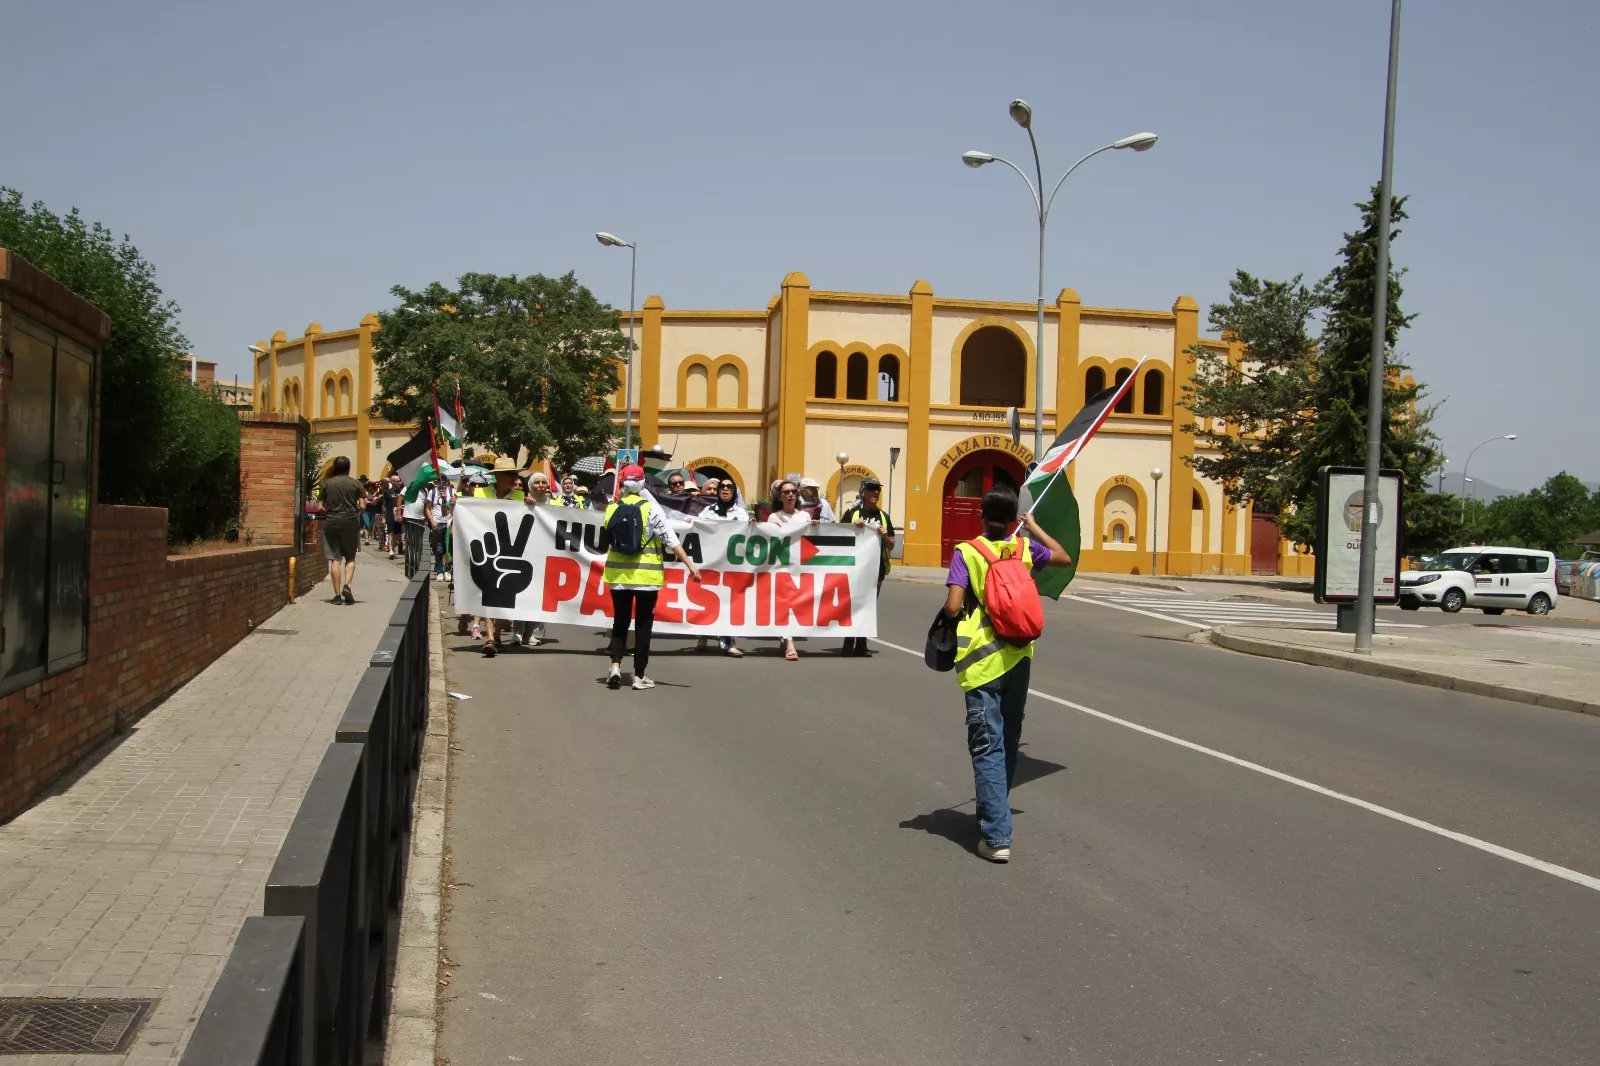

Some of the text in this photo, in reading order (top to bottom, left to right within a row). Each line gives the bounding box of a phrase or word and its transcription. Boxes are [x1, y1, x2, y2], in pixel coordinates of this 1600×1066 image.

[993, 412, 1005, 422] 192
[939, 436, 1034, 470] PLAZA DE TORO
[726, 533, 792, 566] CON
[541, 555, 853, 627] PAESTINA
